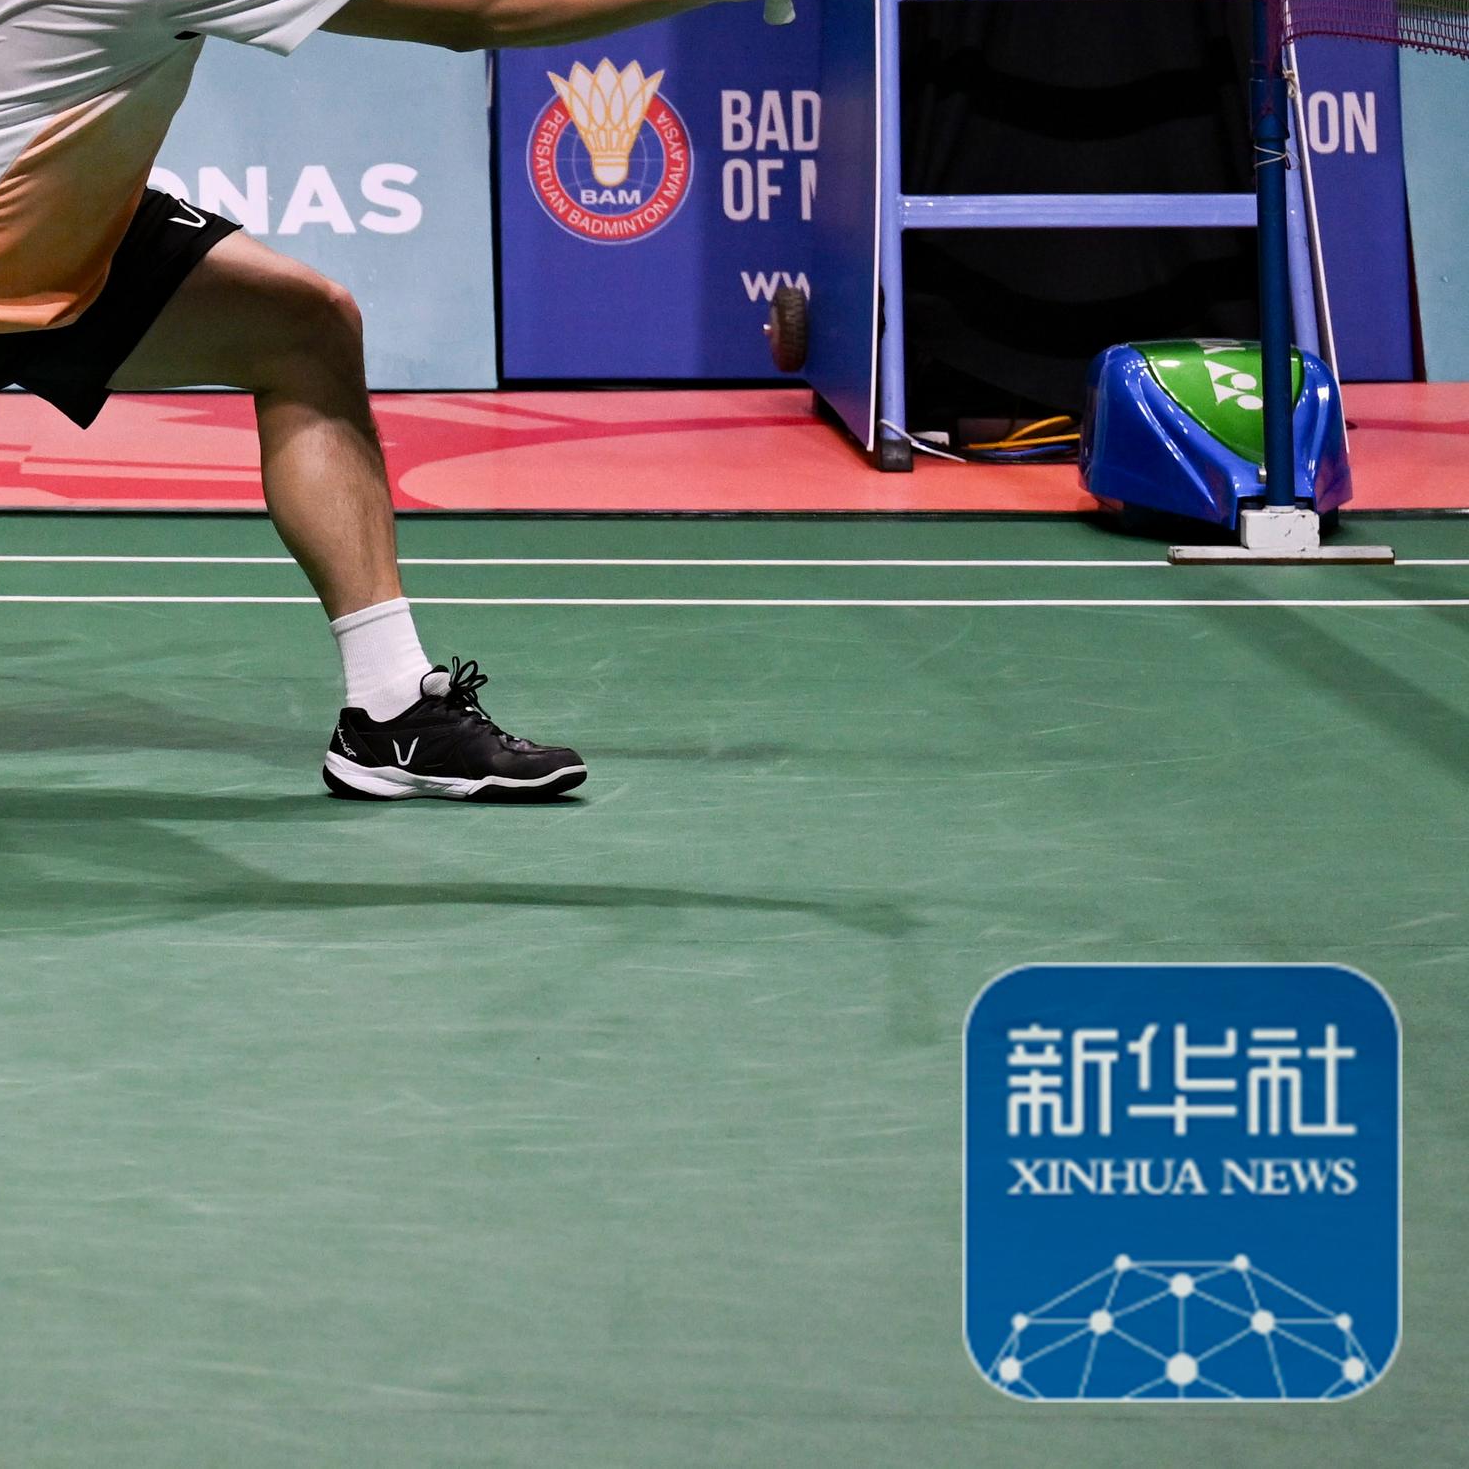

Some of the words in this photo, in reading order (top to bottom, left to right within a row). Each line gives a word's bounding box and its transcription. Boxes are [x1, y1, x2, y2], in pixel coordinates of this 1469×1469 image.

[1301, 90, 1377, 155] ON
[535, 109, 569, 213] PERSATUAN
[656, 111, 684, 199] MALAYSIA
[567, 201, 668, 235] BADMINTON
[580, 189, 642, 205] BAM
[722, 159, 784, 221] OF
